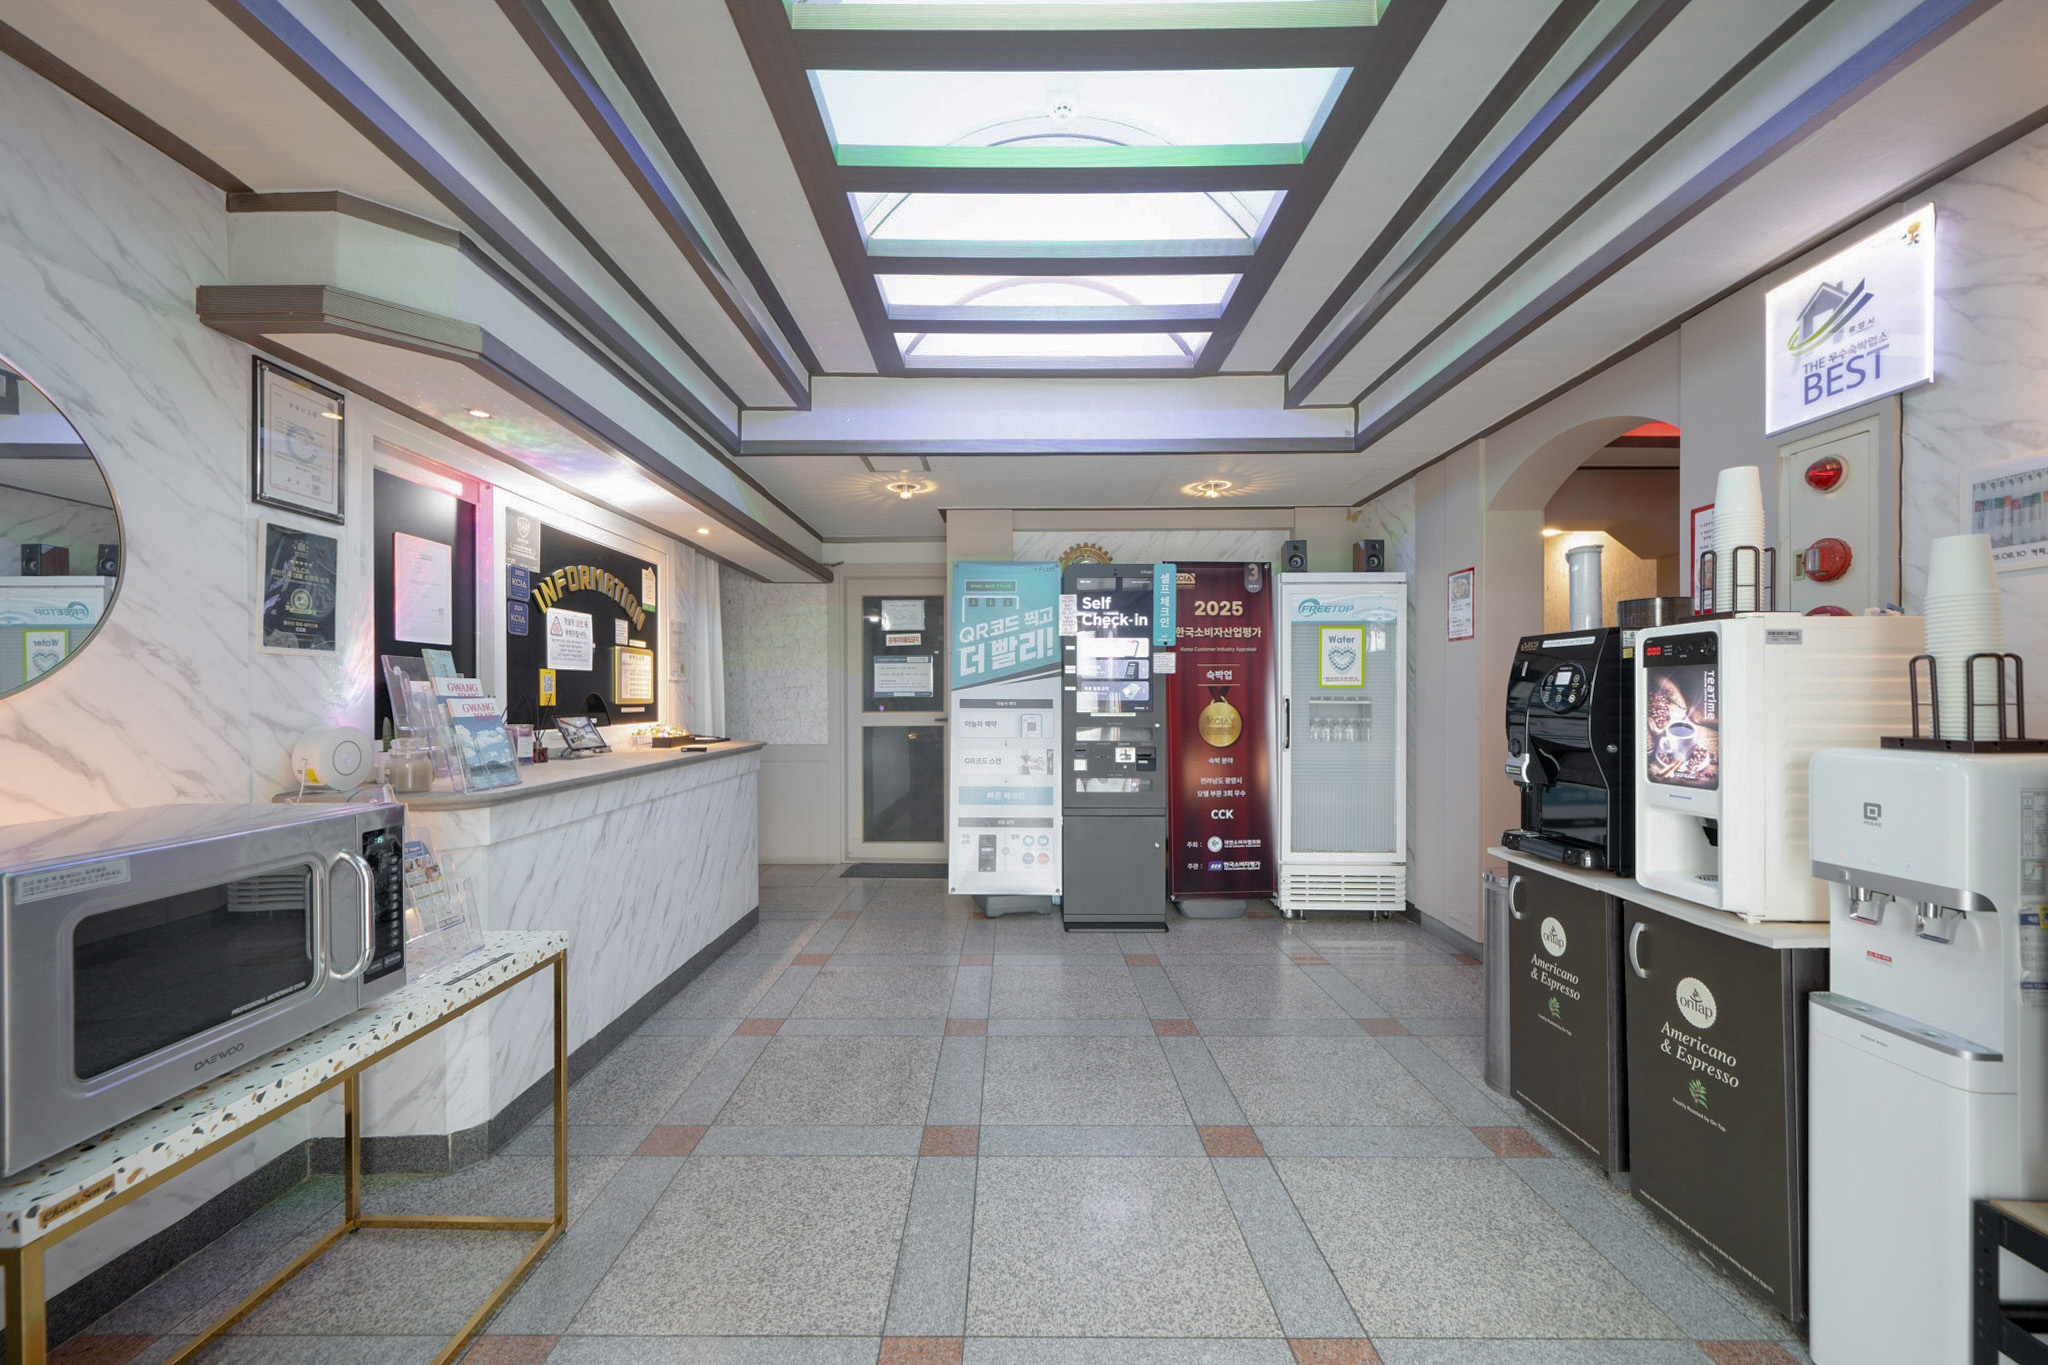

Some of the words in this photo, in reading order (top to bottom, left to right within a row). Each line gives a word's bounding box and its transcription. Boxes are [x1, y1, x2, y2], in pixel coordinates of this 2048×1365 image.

[1803, 356, 1826, 375] THE
[1804, 344, 1890, 405] BEST
[1248, 564, 1259, 581] 3
[511, 578, 527, 588] KCIA
[532, 565, 646, 631] INFORMATION
[1082, 597, 1112, 609] Self
[1160, 573, 1170, 628] 셀프체크인
[1194, 601, 1243, 616] 2025
[1300, 603, 1355, 615] FREETOP
[959, 614, 1020, 643] QR코드
[1024, 606, 1053, 626] 찍고
[1081, 613, 1148, 626] Check-in
[1176, 627, 1262, 638] 한국소비자산업평가
[1329, 635, 1356, 644] Water
[956, 643, 985, 676] 더
[987, 626, 1054, 670] 빨리!
[1206, 670, 1233, 680] 숙박업
[447, 683, 478, 692] GWANG
[462, 703, 495, 713] GWANG
[473, 712, 498, 721] YANG
[985, 720, 997, 728] 예약
[1211, 809, 1234, 819] CCK
[1531, 953, 1579, 985] Americano
[1531, 967, 1538, 980] &
[1540, 971, 1580, 1001] Espresso
[1680, 996, 1713, 1019] onTap
[1660, 1021, 1737, 1067] Americano
[194, 1043, 245, 1071] DAEWOO
[1660, 1038, 1671, 1055] &
[1675, 1045, 1739, 1088] Espresso
